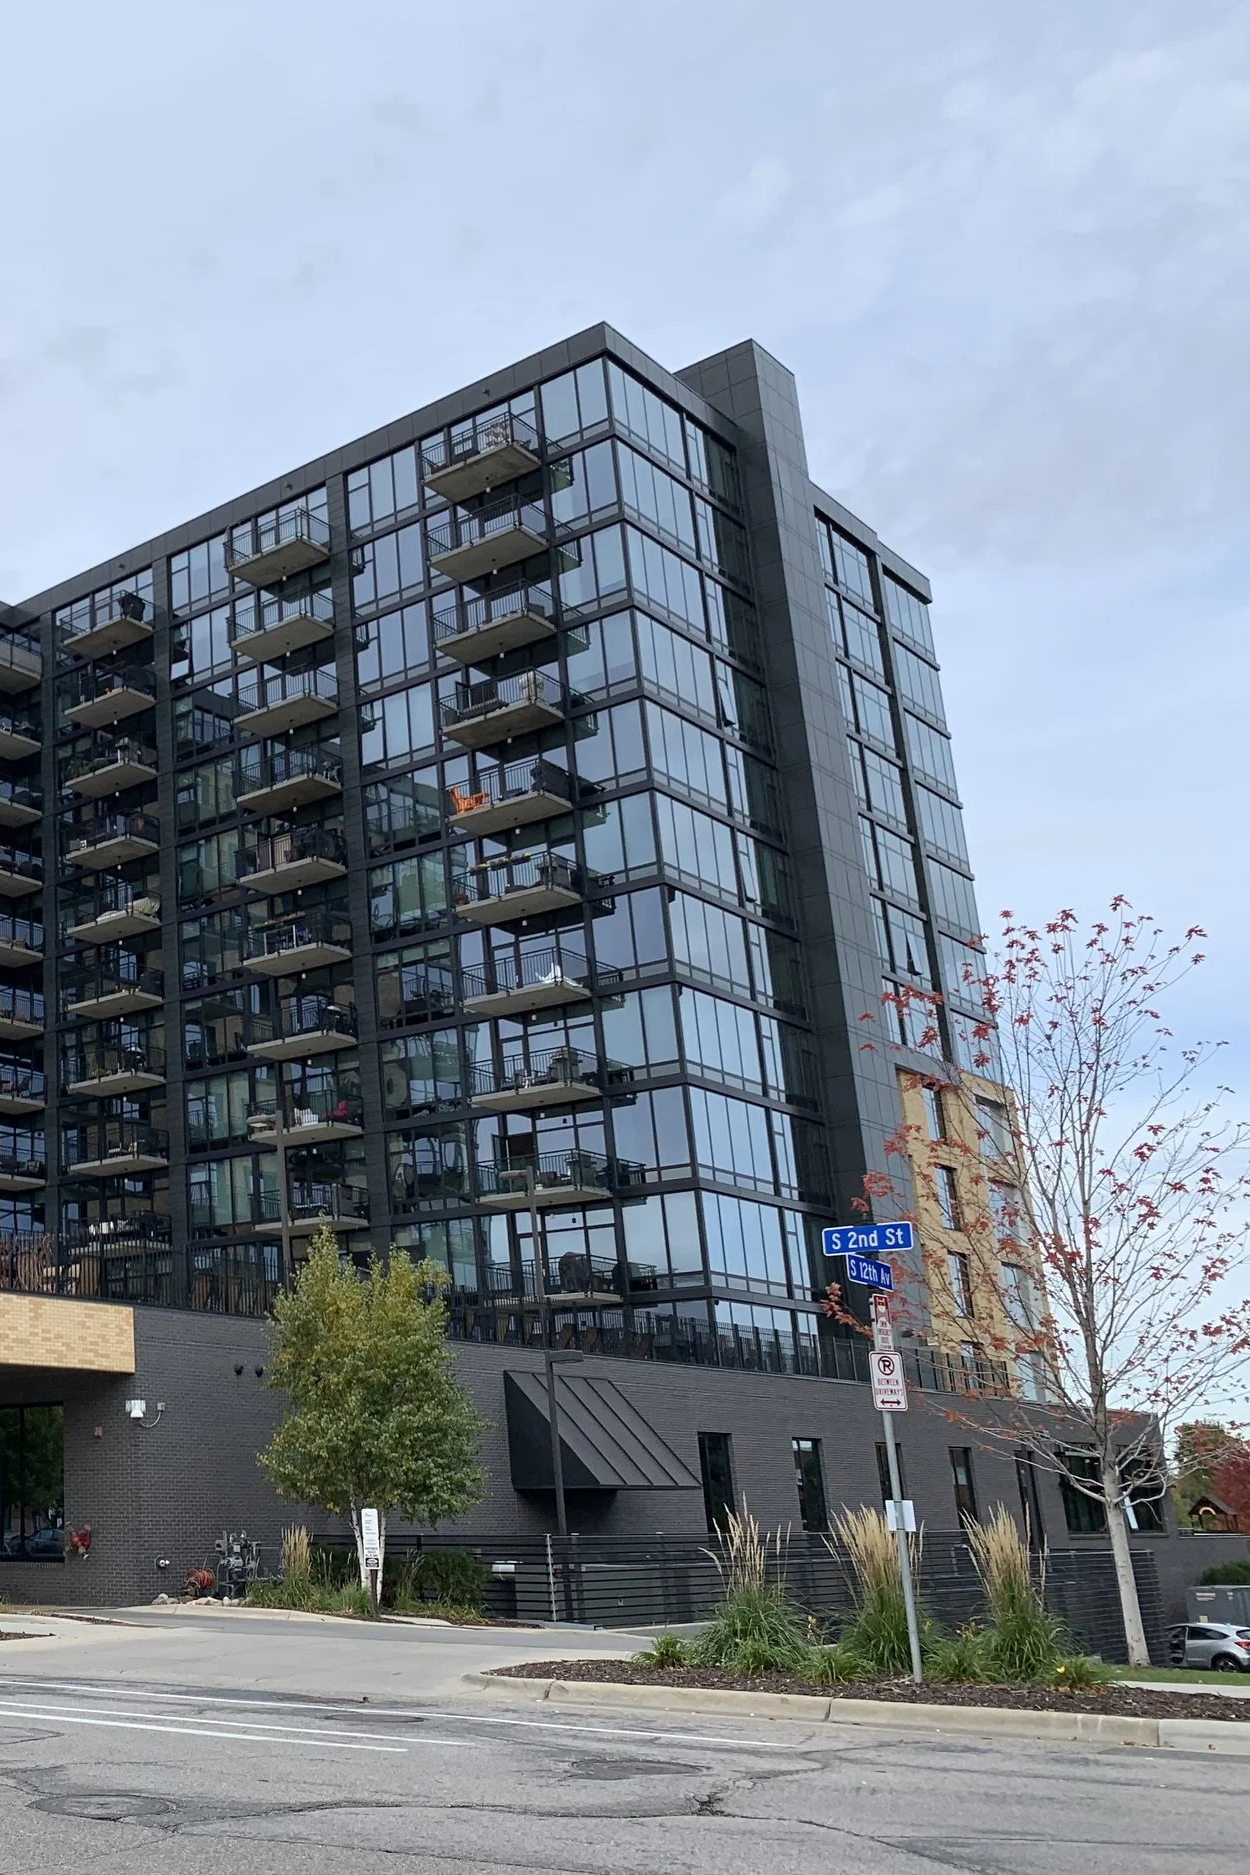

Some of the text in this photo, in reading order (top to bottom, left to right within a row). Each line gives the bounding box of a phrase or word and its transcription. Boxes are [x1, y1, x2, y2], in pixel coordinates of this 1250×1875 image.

[831, 1227, 904, 1250] S 2nd St
[850, 1259, 890, 1286] S 12th Av
[877, 1377, 899, 1386] BETWEEN
